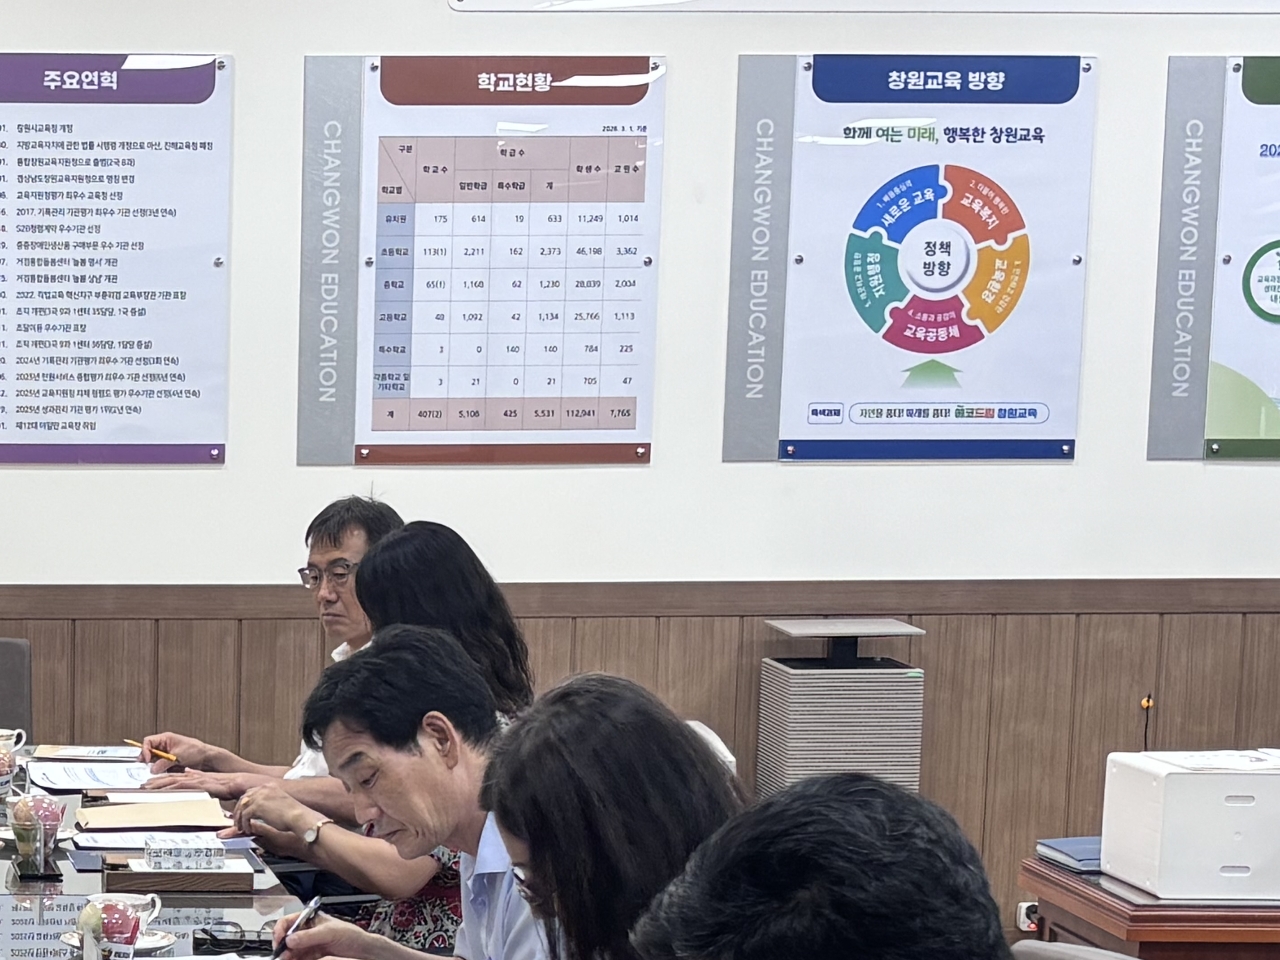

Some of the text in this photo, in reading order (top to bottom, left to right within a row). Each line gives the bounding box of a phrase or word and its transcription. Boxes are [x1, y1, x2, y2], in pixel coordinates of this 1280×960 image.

[42, 70, 119, 90] 주요연혁
[477, 72, 552, 92] 학교현황
[887, 70, 1005, 91] 창원교육 방향
[842, 126, 1046, 145] 함께 여는 미래, 행복한 창원교육
[65, 141, 80, 151] 관한
[116, 207, 131, 218] 기관
[880, 187, 937, 228] 새로운 교육
[960, 192, 1000, 230] 교육복지
[433, 214, 448, 224] 175
[471, 214, 486, 224] 614
[514, 214, 525, 224] 19
[547, 214, 563, 224] 633
[577, 214, 604, 224] 11,249
[618, 214, 639, 224] 1,014
[423, 247, 447, 257] 113(1)
[463, 247, 485, 257] 2,211
[509, 247, 524, 257] 162
[540, 247, 562, 257] 2,373
[575, 247, 603, 257] 46,198
[616, 247, 638, 257] 3,362
[923, 240, 952, 257] 정책
[319, 120, 342, 402] CHANGWON EDUCATION
[745, 118, 774, 400] CHANGWON EDUCATION
[1171, 119, 1203, 397] CHANGWON EDUCATION
[922, 260, 951, 277] 방향
[425, 280, 446, 289] 65(1)
[511, 280, 522, 289] 62
[539, 280, 560, 289] 1,230
[462, 312, 484, 322] 1,092
[510, 312, 521, 322] 42
[538, 312, 559, 322] 1,134
[614, 312, 635, 322] 1,113
[903, 323, 960, 342] 교육공동체
[417, 409, 443, 419] 407(2)
[503, 409, 518, 419] 425
[534, 409, 555, 419] 5,531
[997, 408, 1038, 420] 창원교육
